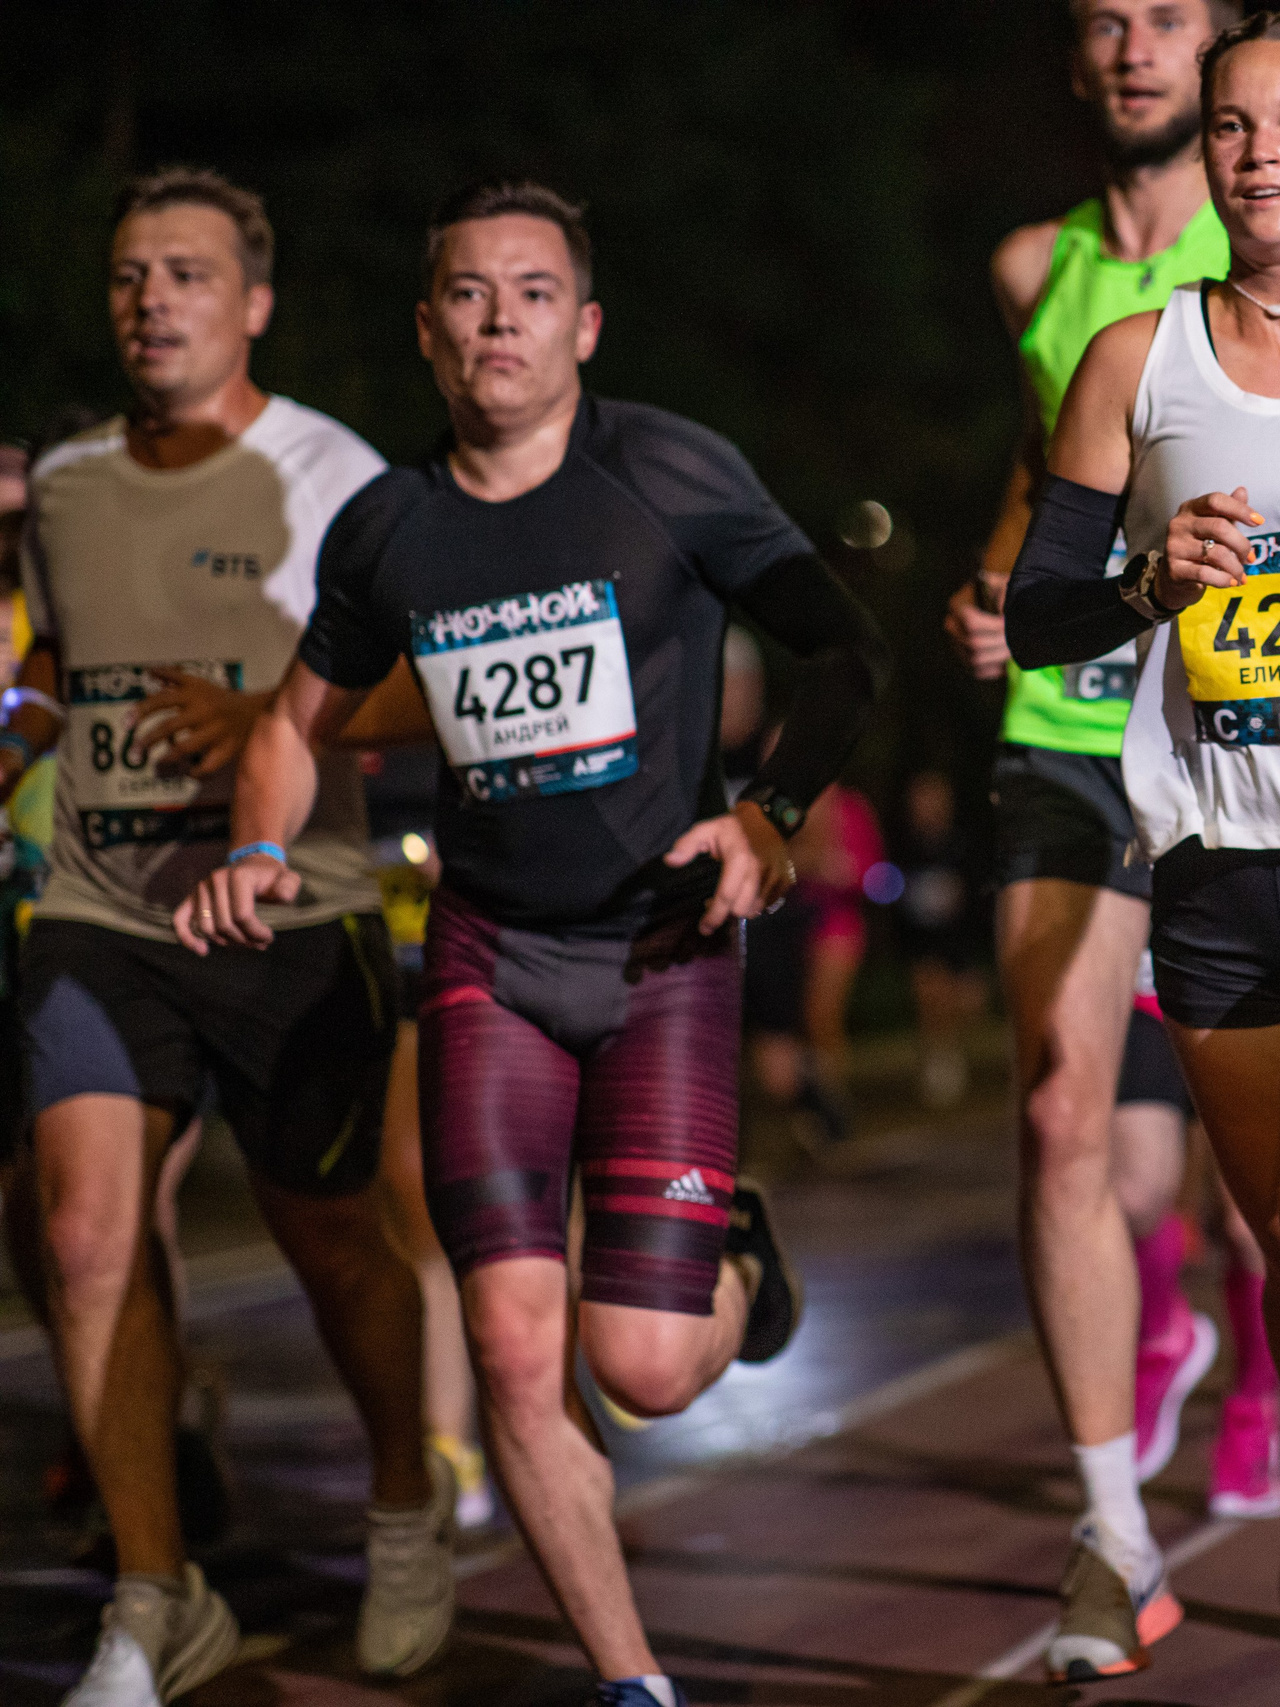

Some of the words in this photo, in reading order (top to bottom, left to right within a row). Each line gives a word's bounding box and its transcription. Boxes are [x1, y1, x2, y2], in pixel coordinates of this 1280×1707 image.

[454, 644, 596, 724] 4287
[90, 722, 149, 771] 86
[492, 714, 571, 746] АНДРЕЙ
